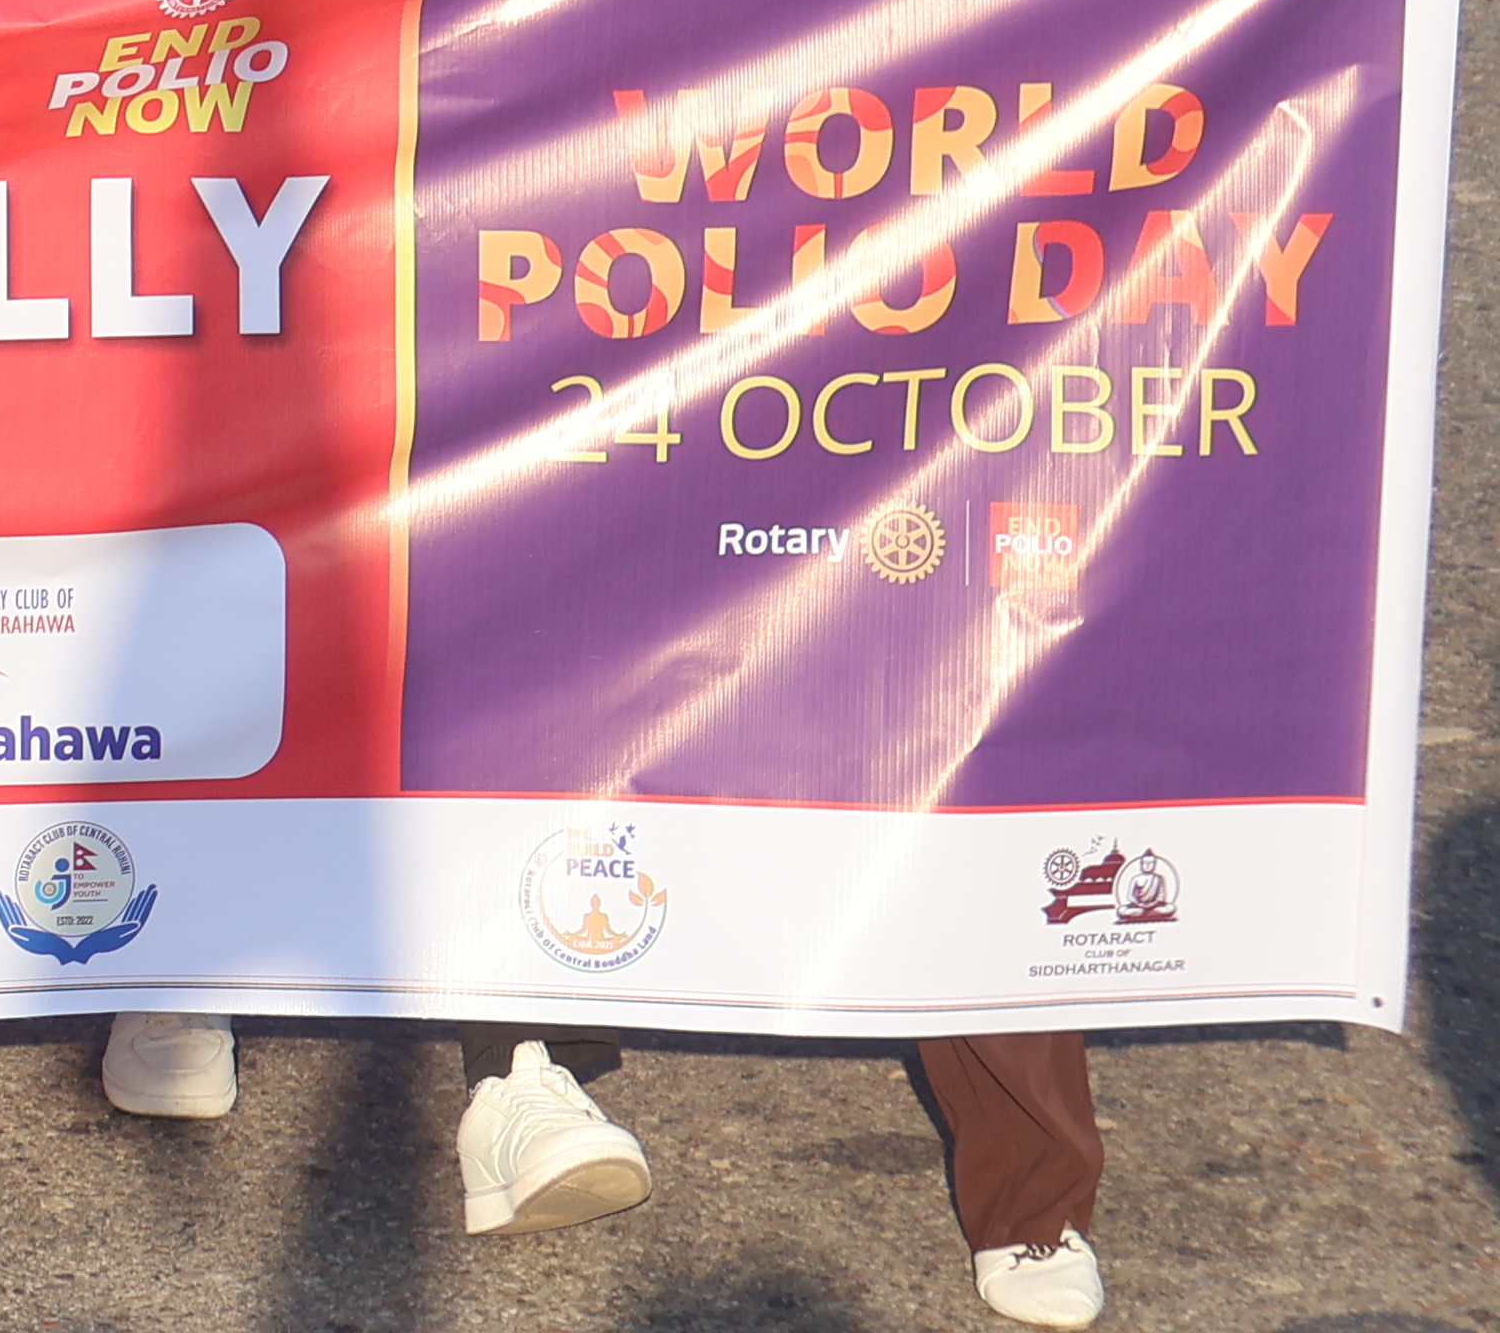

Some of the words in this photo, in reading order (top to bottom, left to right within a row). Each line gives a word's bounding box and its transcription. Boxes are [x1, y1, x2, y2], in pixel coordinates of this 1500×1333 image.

[99, 16, 262, 72] END
[47, 40, 289, 109] POLIO
[65, 81, 254, 137] NOW
[612, 82, 1205, 203] WORLD
[478, 223, 957, 343] POLIO
[1008, 210, 1333, 329] DAY
[549, 374, 681, 463] 24
[720, 365, 1259, 460] OCTOBER
[718, 523, 850, 564] Rotary
[995, 533, 1072, 557] POLIO
[15, 588, 50, 611] CLUB
[57, 587, 75, 608] OF
[566, 858, 635, 878] PEACE
[1062, 930, 1156, 947] ROTARACT
[1084, 949, 1112, 960] CLUB
[1116, 949, 1131, 959] OF
[1028, 958, 1186, 978] SIDDHARTHANAGAR
